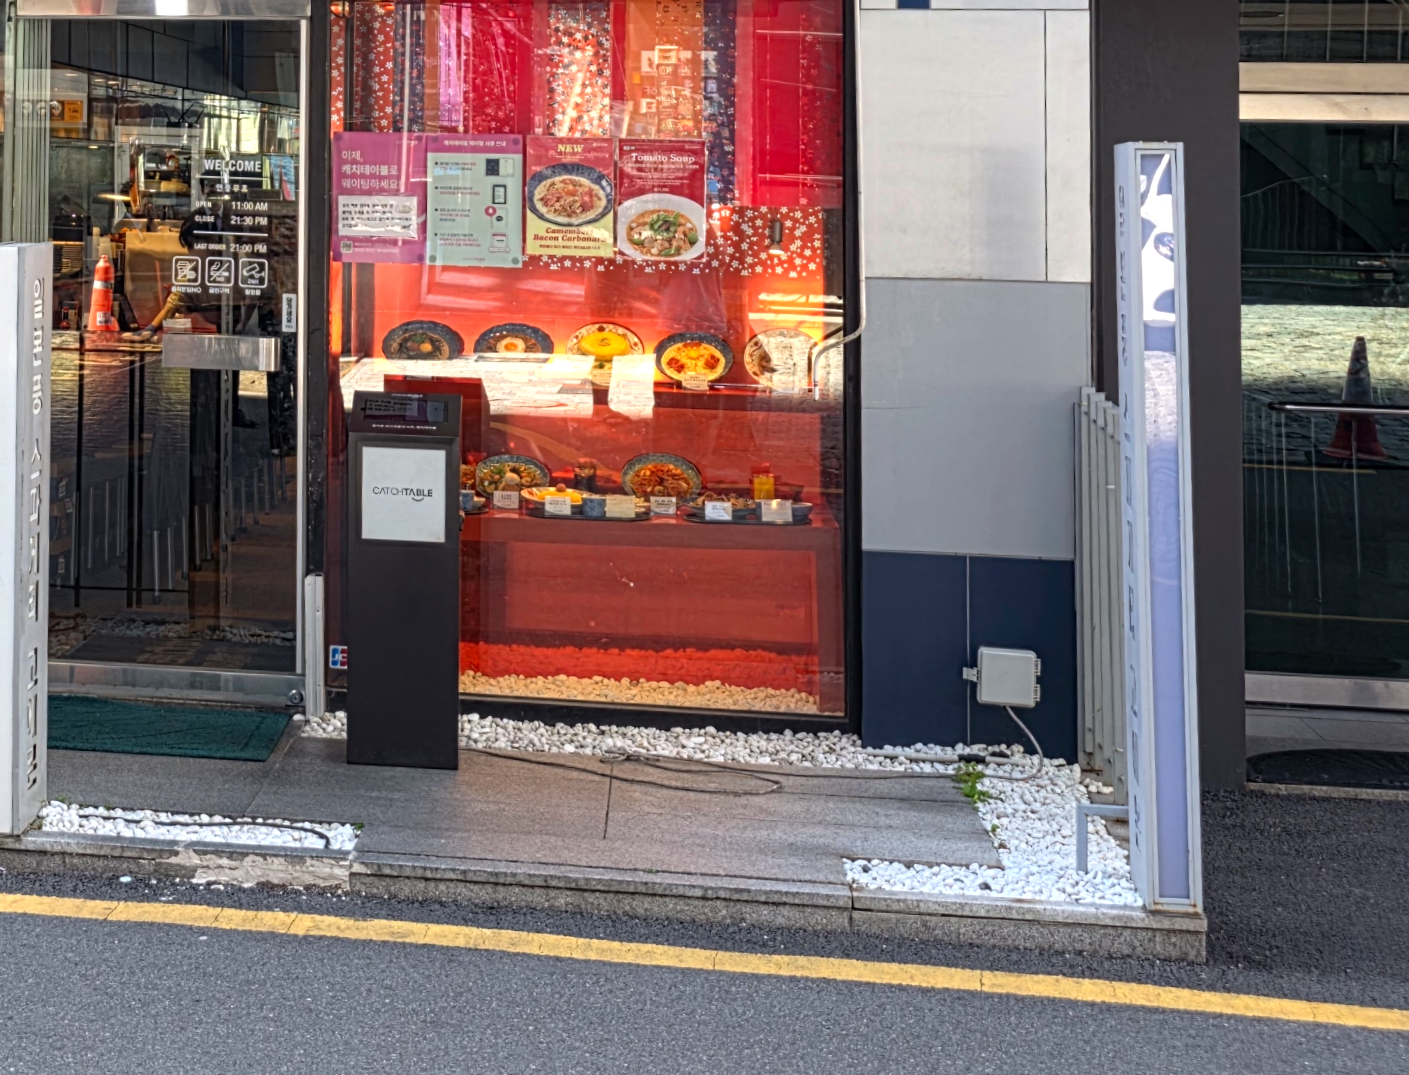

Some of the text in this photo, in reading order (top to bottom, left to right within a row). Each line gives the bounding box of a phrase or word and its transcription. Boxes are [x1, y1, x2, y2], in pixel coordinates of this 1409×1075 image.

[557, 143, 584, 153] NEW
[341, 150, 363, 162] 이제,
[631, 152, 695, 164] Tomato Soup
[203, 159, 262, 172] WELCOME
[231, 201, 254, 211] 11:00
[254, 202, 268, 211] AM
[194, 215, 268, 226] CLOSE 21:30 PM
[533, 234, 559, 242] Bacon
[194, 242, 268, 254] LAST ORDER 21:00 PM
[372, 486, 433, 498] CATCHTABLE
